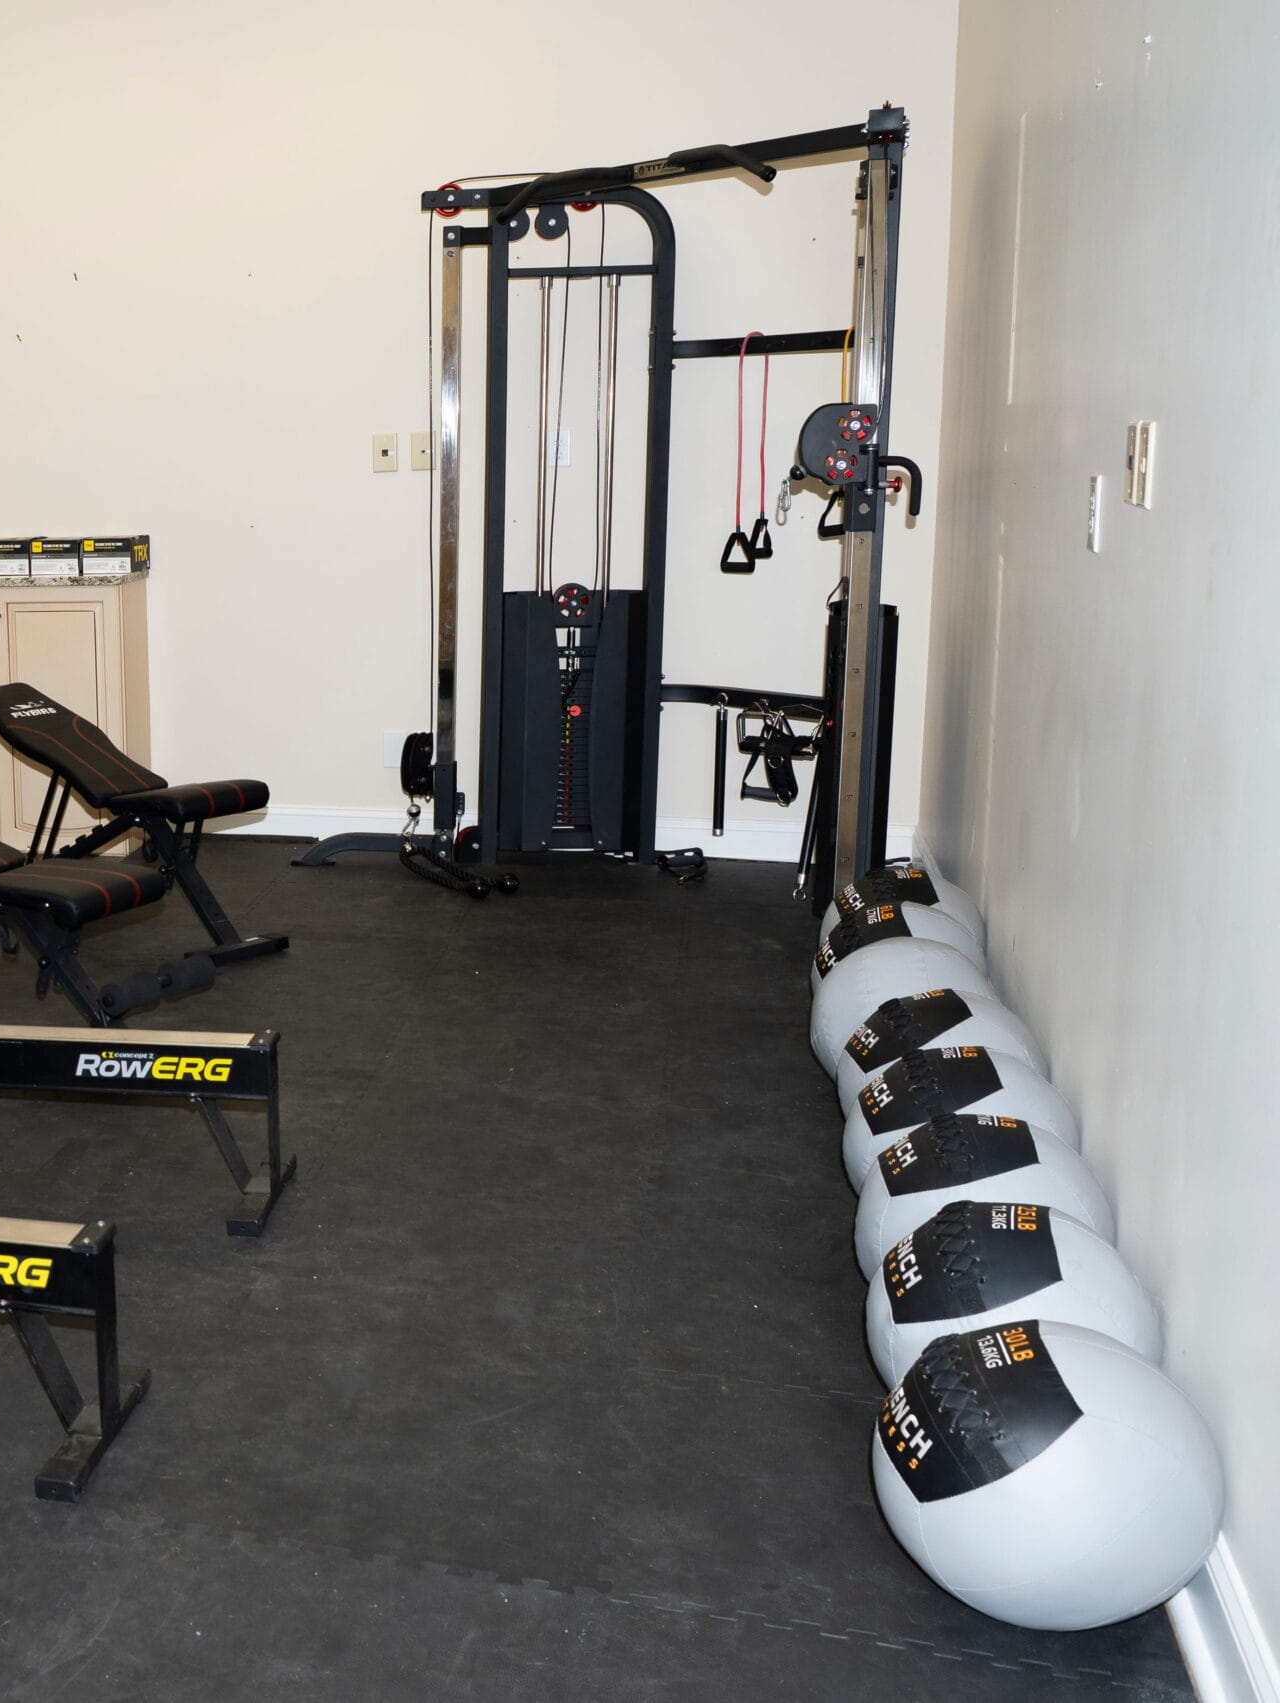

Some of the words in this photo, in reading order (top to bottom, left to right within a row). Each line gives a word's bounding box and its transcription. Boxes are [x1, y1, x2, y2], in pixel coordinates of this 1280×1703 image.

[646, 161, 673, 172] TITA
[134, 544, 149, 562] TRX
[10, 707, 57, 719] FLYBIRD
[1017, 1205, 1037, 1232] 25LB
[976, 1334, 1004, 1370] 13.6KG
[1002, 1326, 1035, 1363] 30LB
